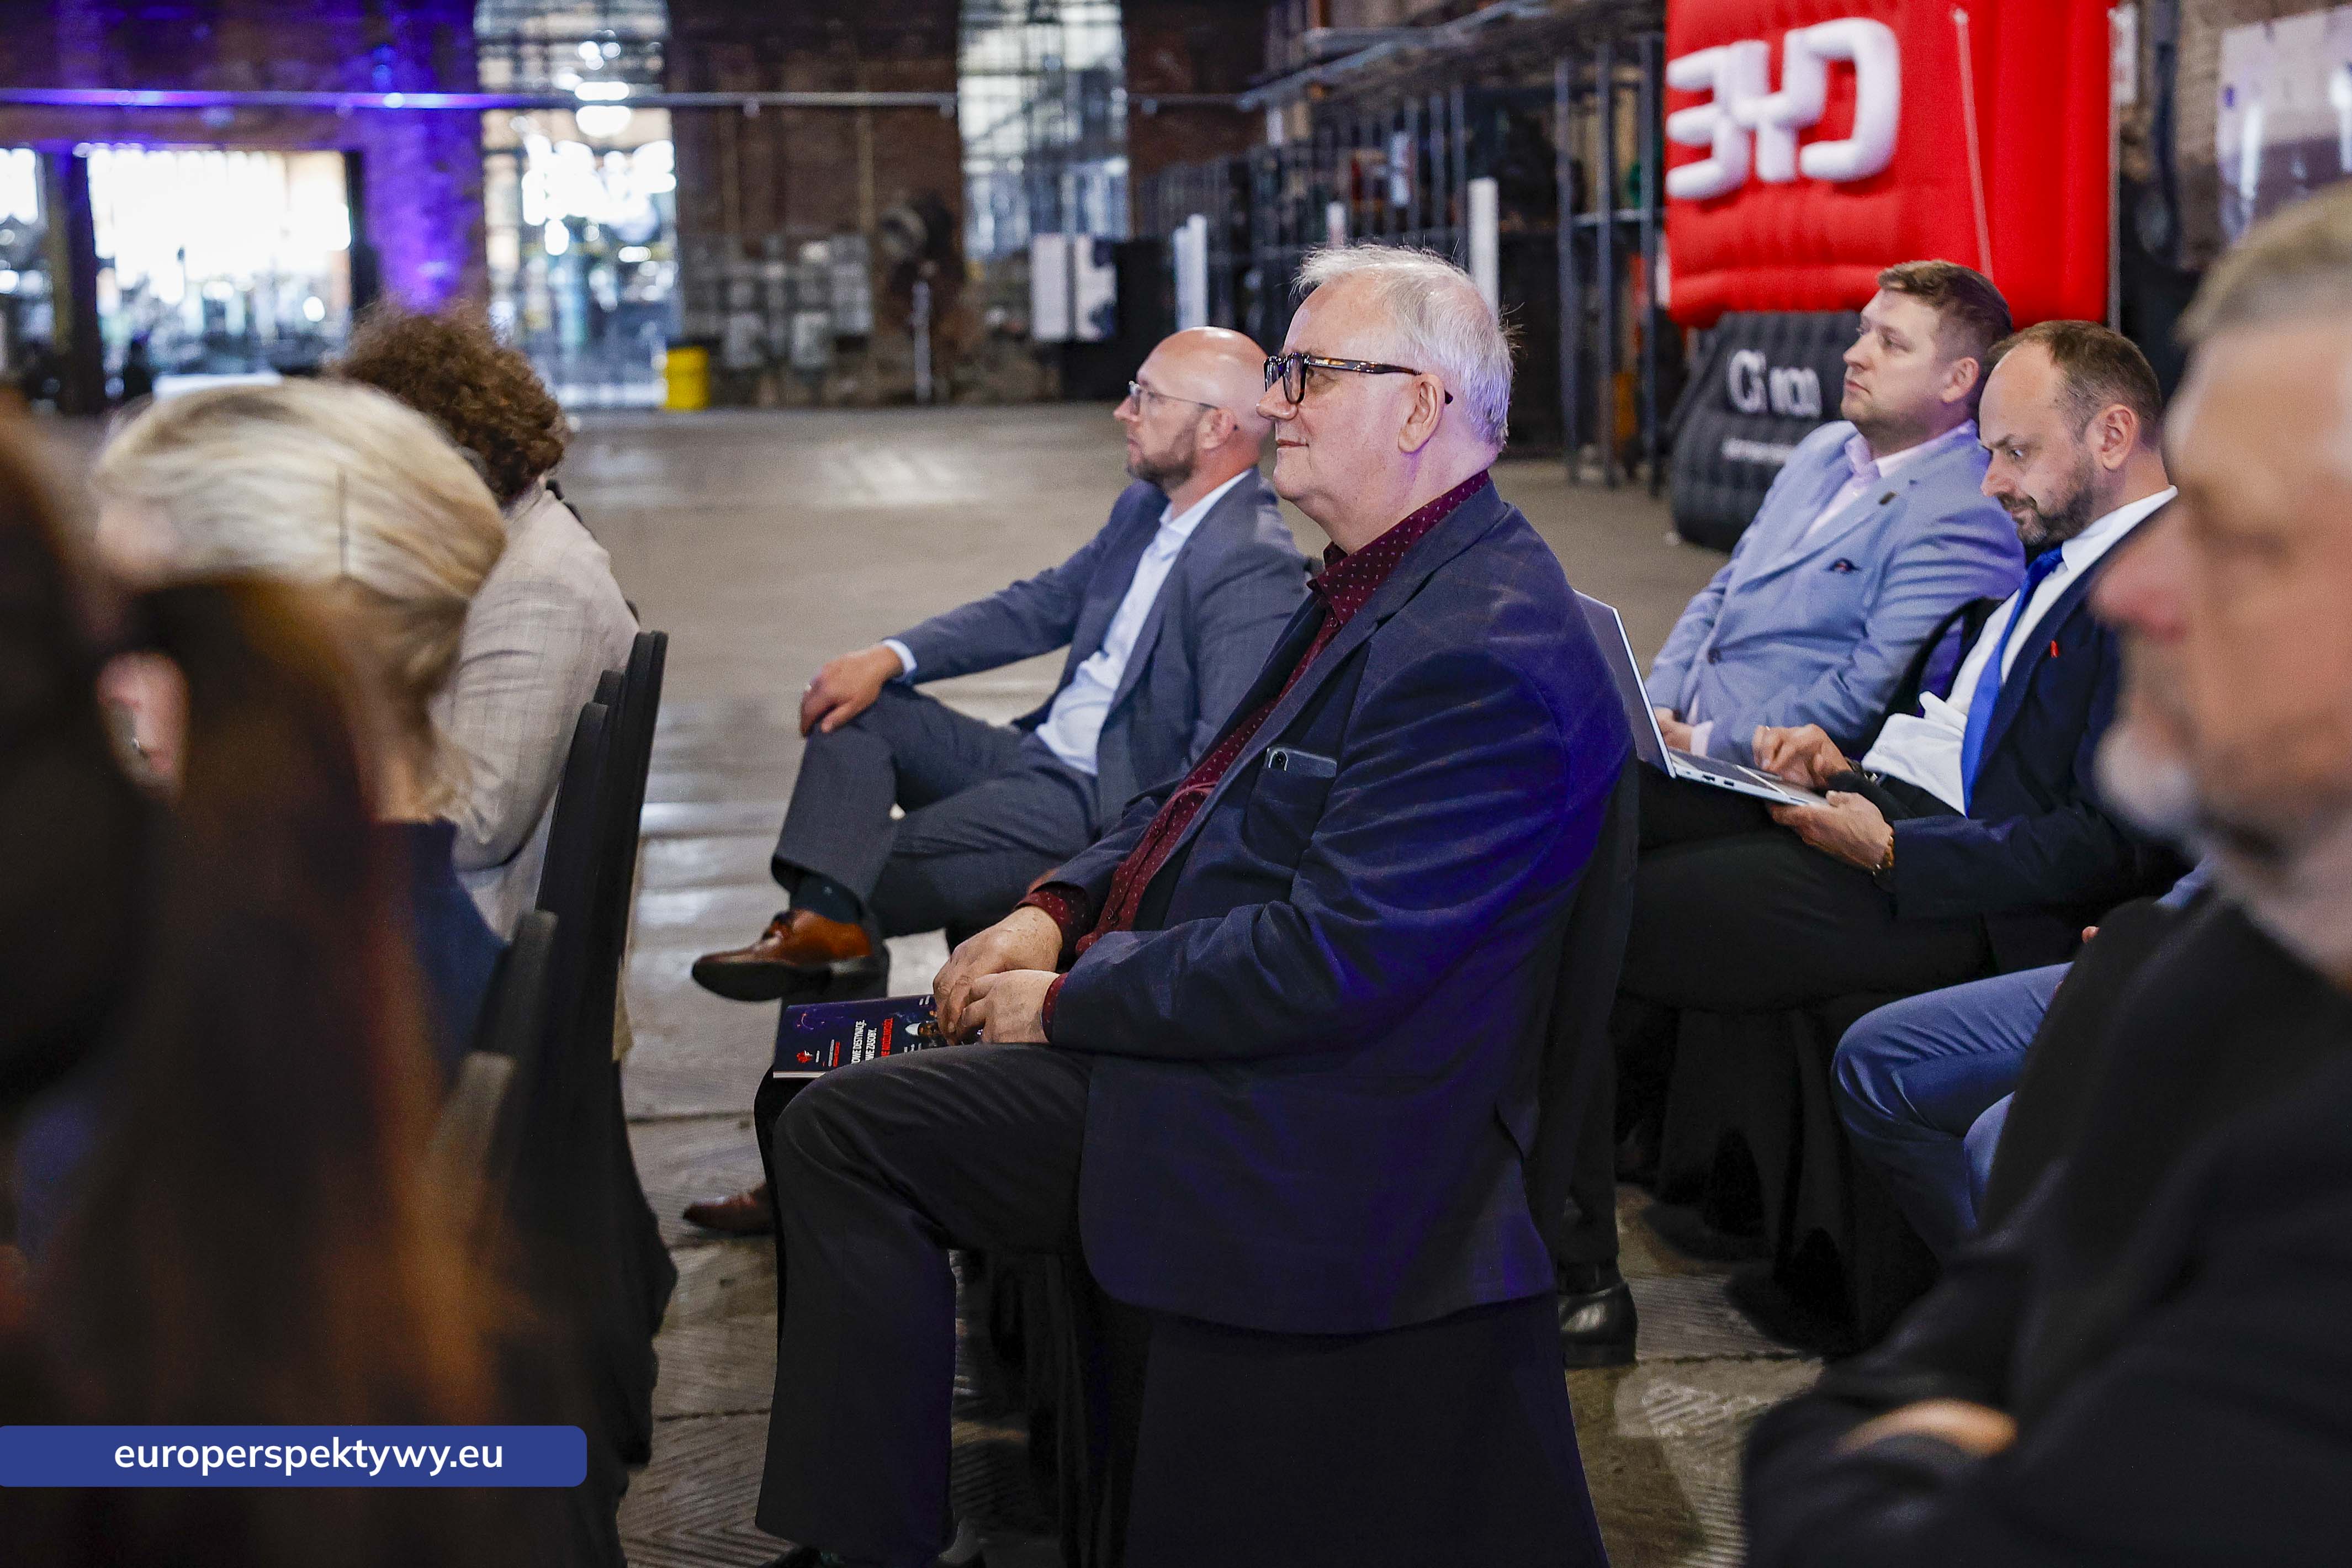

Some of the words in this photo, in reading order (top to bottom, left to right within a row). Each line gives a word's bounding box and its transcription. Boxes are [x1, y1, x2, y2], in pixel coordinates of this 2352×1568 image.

[866, 1028, 877, 1050] ZASOBY.
[851, 1050, 861, 1064] OWE
[865, 1050, 875, 1061] WE
